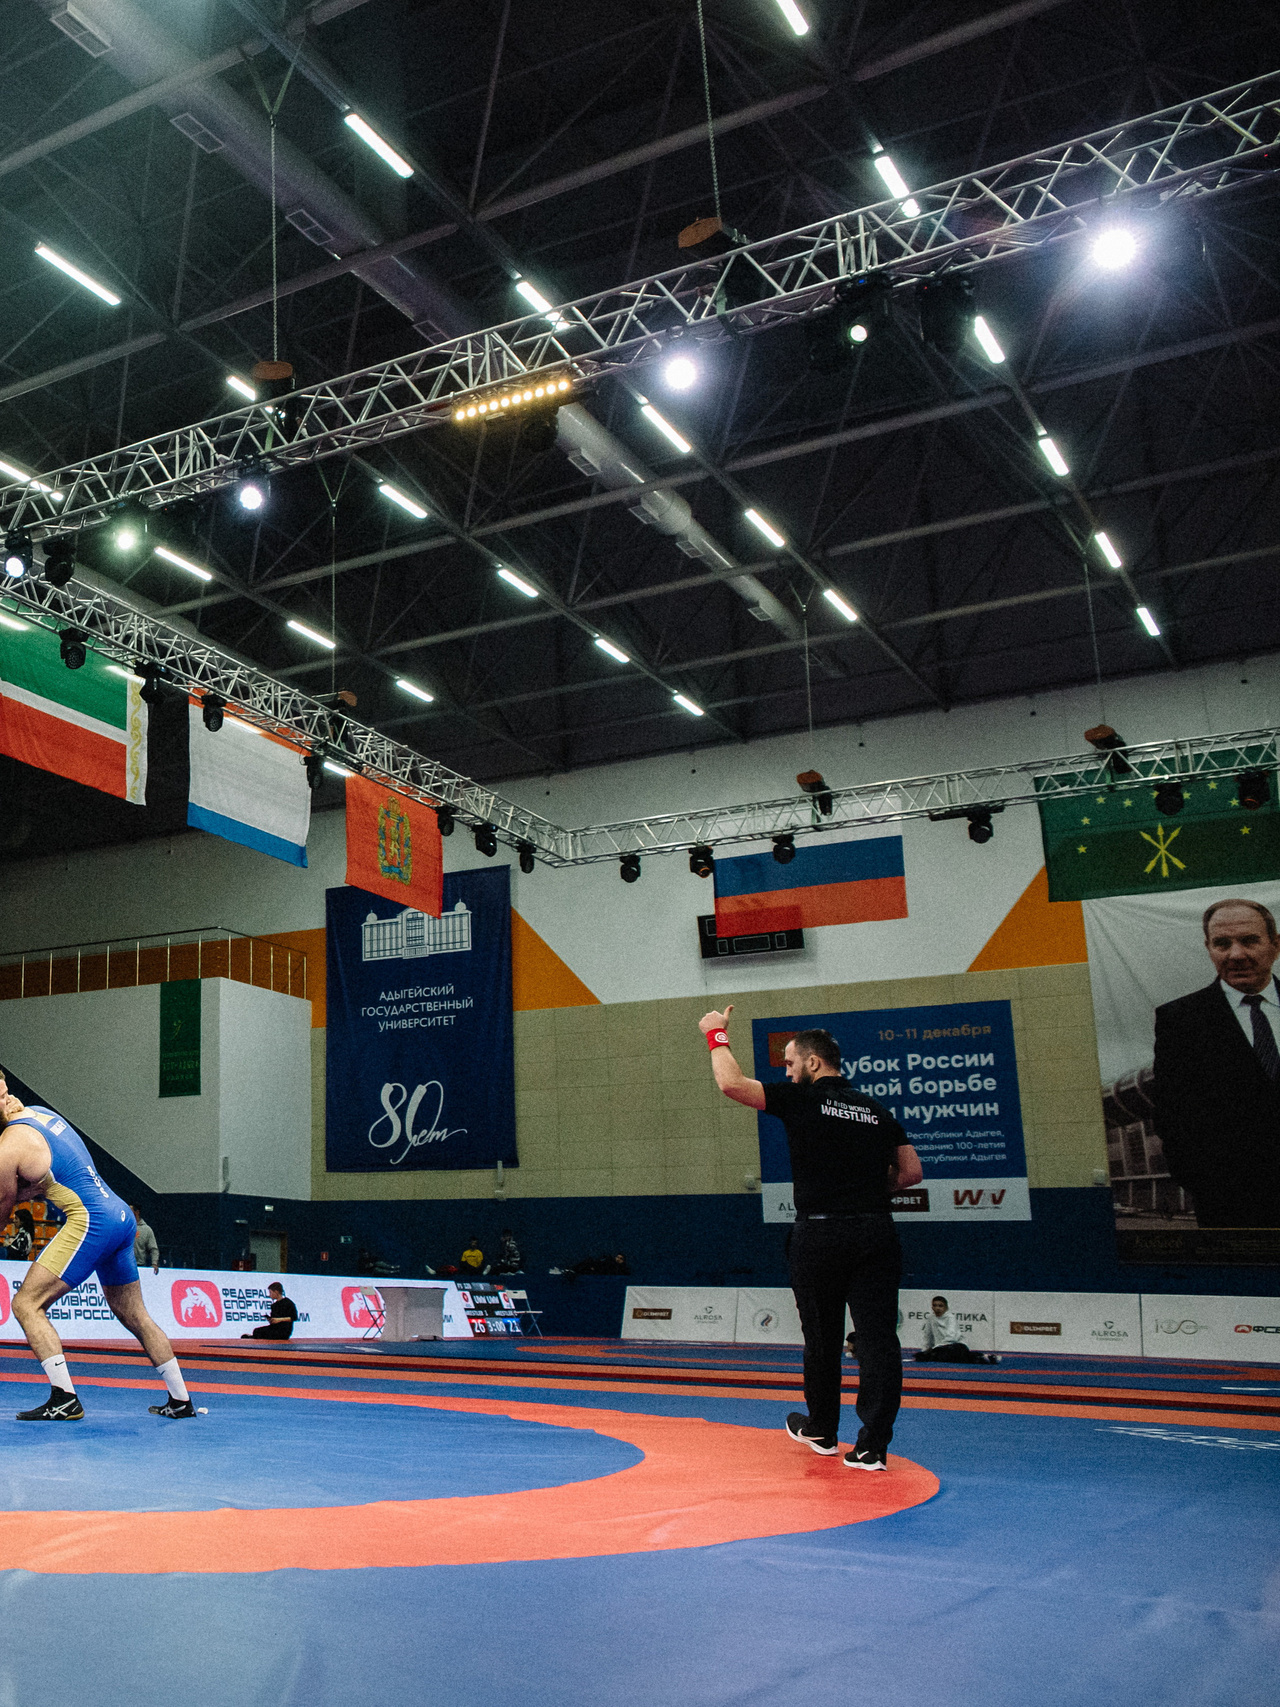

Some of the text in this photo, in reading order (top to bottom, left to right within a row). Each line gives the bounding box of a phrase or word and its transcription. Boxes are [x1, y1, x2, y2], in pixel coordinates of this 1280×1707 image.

[379, 983, 455, 1001] АДЫГЕЙСКИЙ
[361, 997, 474, 1017] ГОСУДАРСТВЕННЫЙ
[378, 1015, 456, 1032] УНИВЕРСИТЕТ
[922, 1024, 992, 1040] декабря
[907, 1052, 995, 1071] России
[858, 1073, 997, 1098] ной борьбе
[826, 1098, 871, 1114] UED WORLD
[904, 1102, 999, 1124] мужчин
[368, 1080, 443, 1149] 80
[821, 1104, 879, 1125] WRESTLING
[906, 1130, 963, 1141] Республики
[914, 1141, 1006, 1151] нованию 100-летия
[919, 1153, 1007, 1164] еспублики Адыгея
[891, 1195, 922, 1206] PBET
[55, 1293, 107, 1307] ТИВНОЙ
[223, 1299, 272, 1310] СПОРТИВ
[908, 1311, 988, 1323] РЕСЛИКА
[472, 1319, 486, 1333] 26
[486, 1320, 506, 1332] 3:00
[1091, 1330, 1129, 1338] ALROSA
